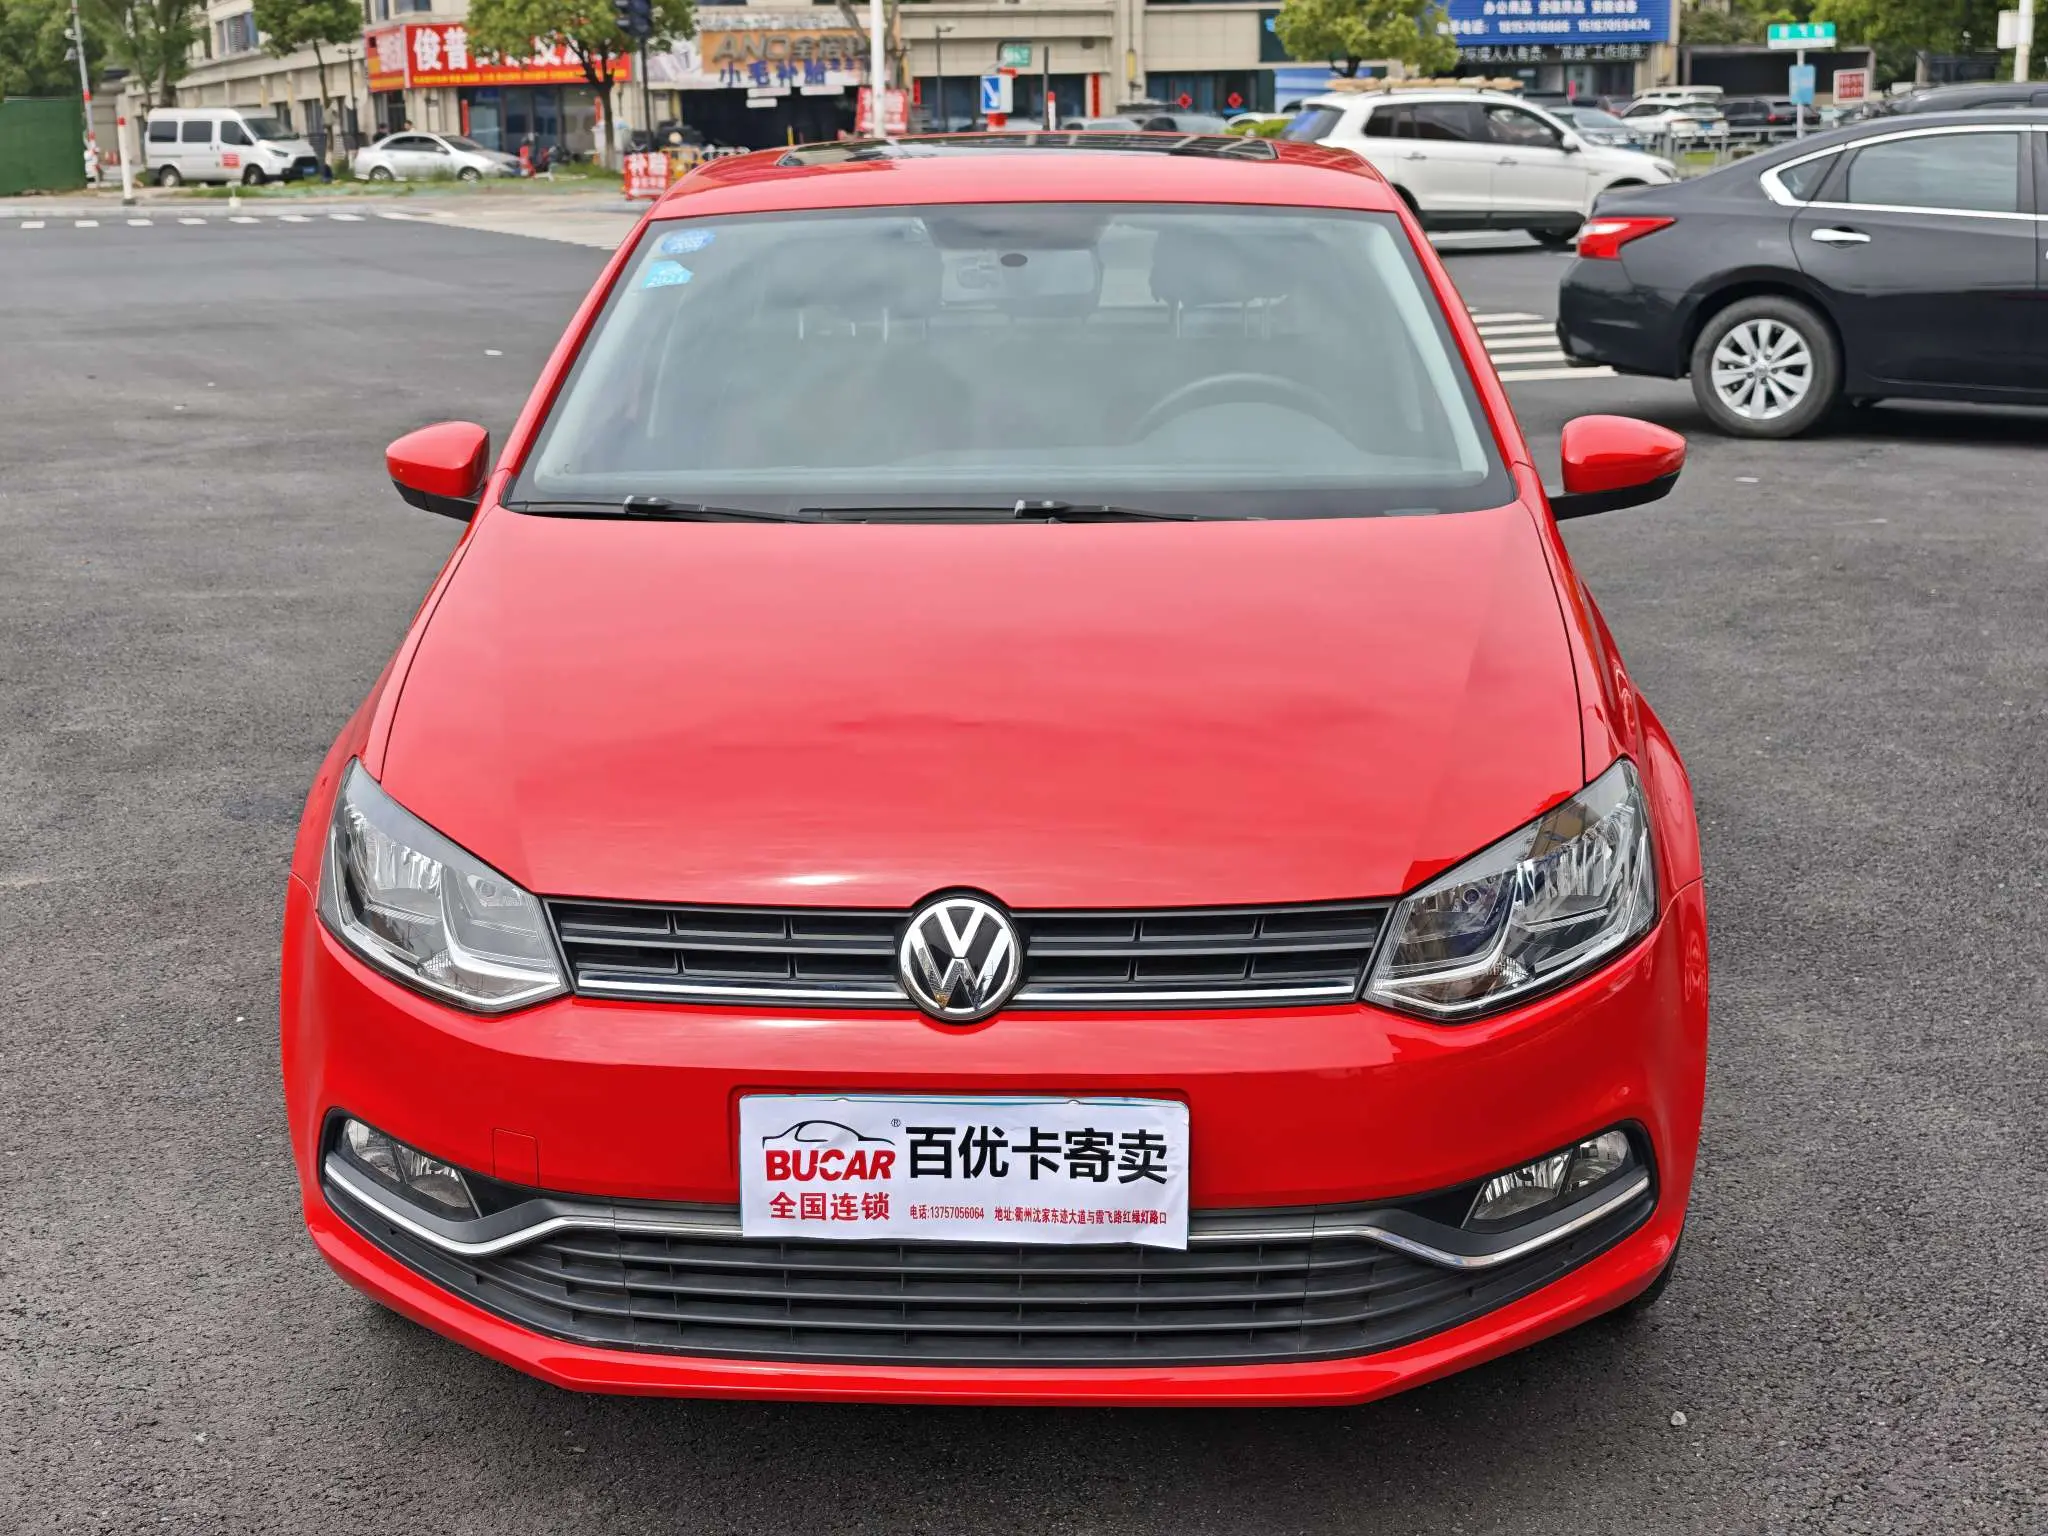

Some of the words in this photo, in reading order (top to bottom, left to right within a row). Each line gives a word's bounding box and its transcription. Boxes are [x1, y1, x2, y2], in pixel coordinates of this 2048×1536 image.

[765, 1149, 896, 1181] BUCAR
[905, 1125, 1168, 1185] 百优卡寄卖
[769, 1191, 890, 1220] 全国连锁
